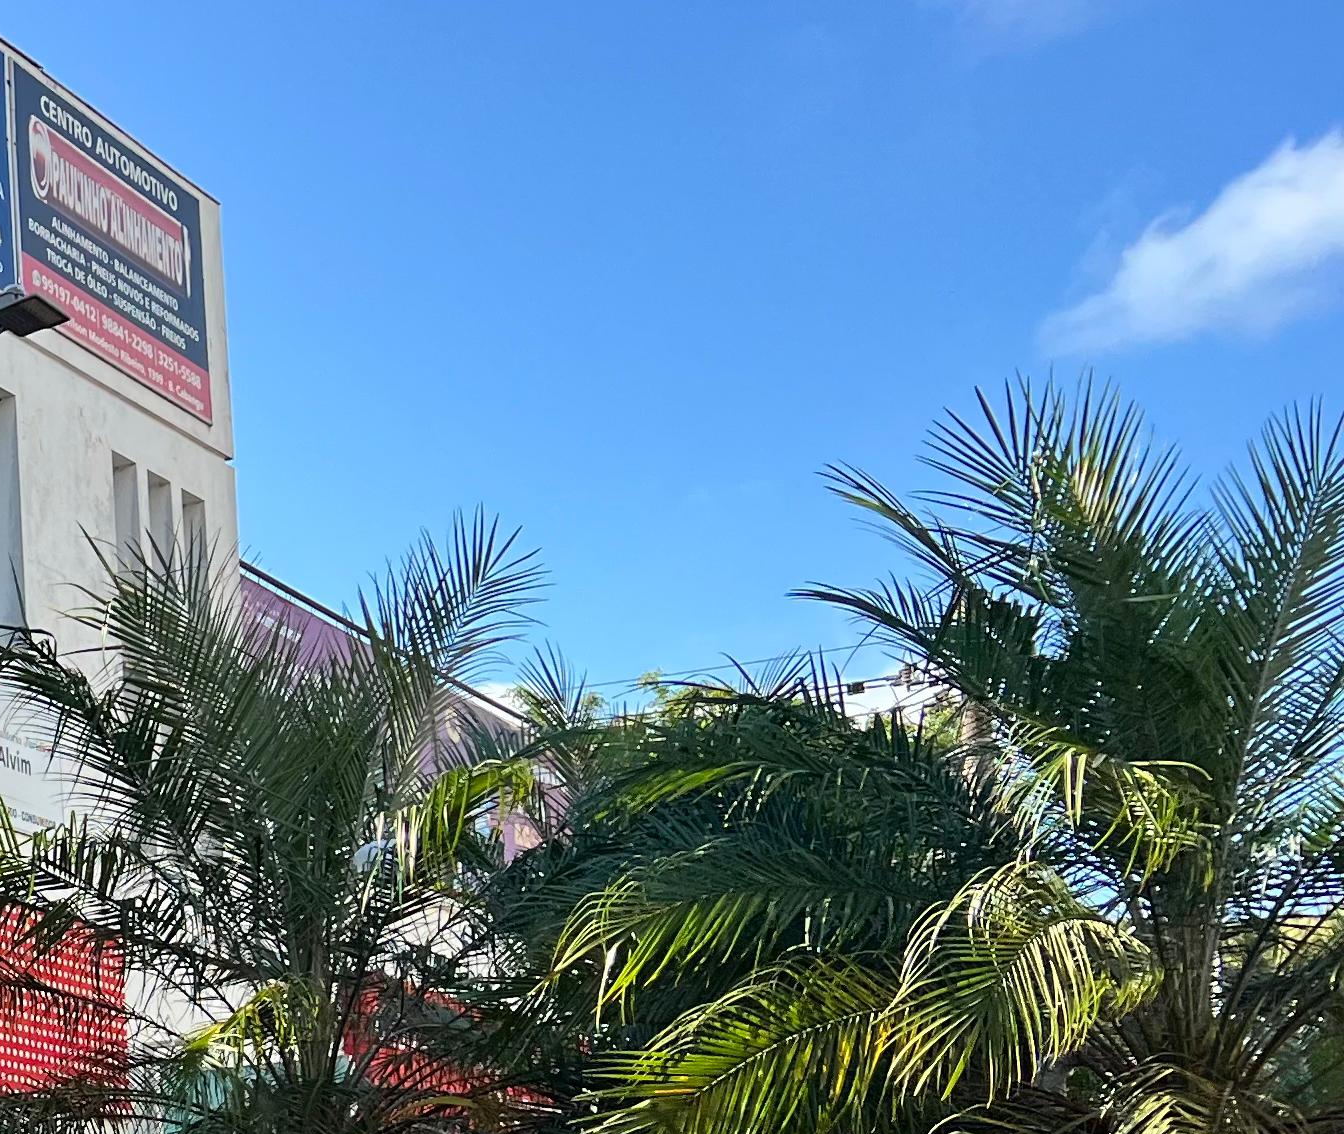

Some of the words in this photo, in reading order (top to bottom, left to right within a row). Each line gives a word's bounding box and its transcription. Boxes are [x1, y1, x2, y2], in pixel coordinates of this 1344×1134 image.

[40, 95, 92, 148] CENTRO
[96, 136, 178, 211] AUTOMOTIVO
[28, 218, 86, 267] BORRACHARIA
[91, 261, 117, 287] PNEUS
[117, 277, 144, 304] NOVOS
[145, 295, 151, 310] E
[151, 298, 200, 342] REFORMADOS
[51, 216, 109, 264] ALINHAMENTO
[113, 260, 179, 311] BALANCEAMENTO
[110, 192, 183, 287] ALINHAMENTO
[46, 248, 74, 277] TROCA
[74, 267, 86, 284] DE
[86, 273, 108, 298] ÓLEO
[113, 292, 157, 331] SUSPENSÃO
[161, 325, 186, 350] FREIOS
